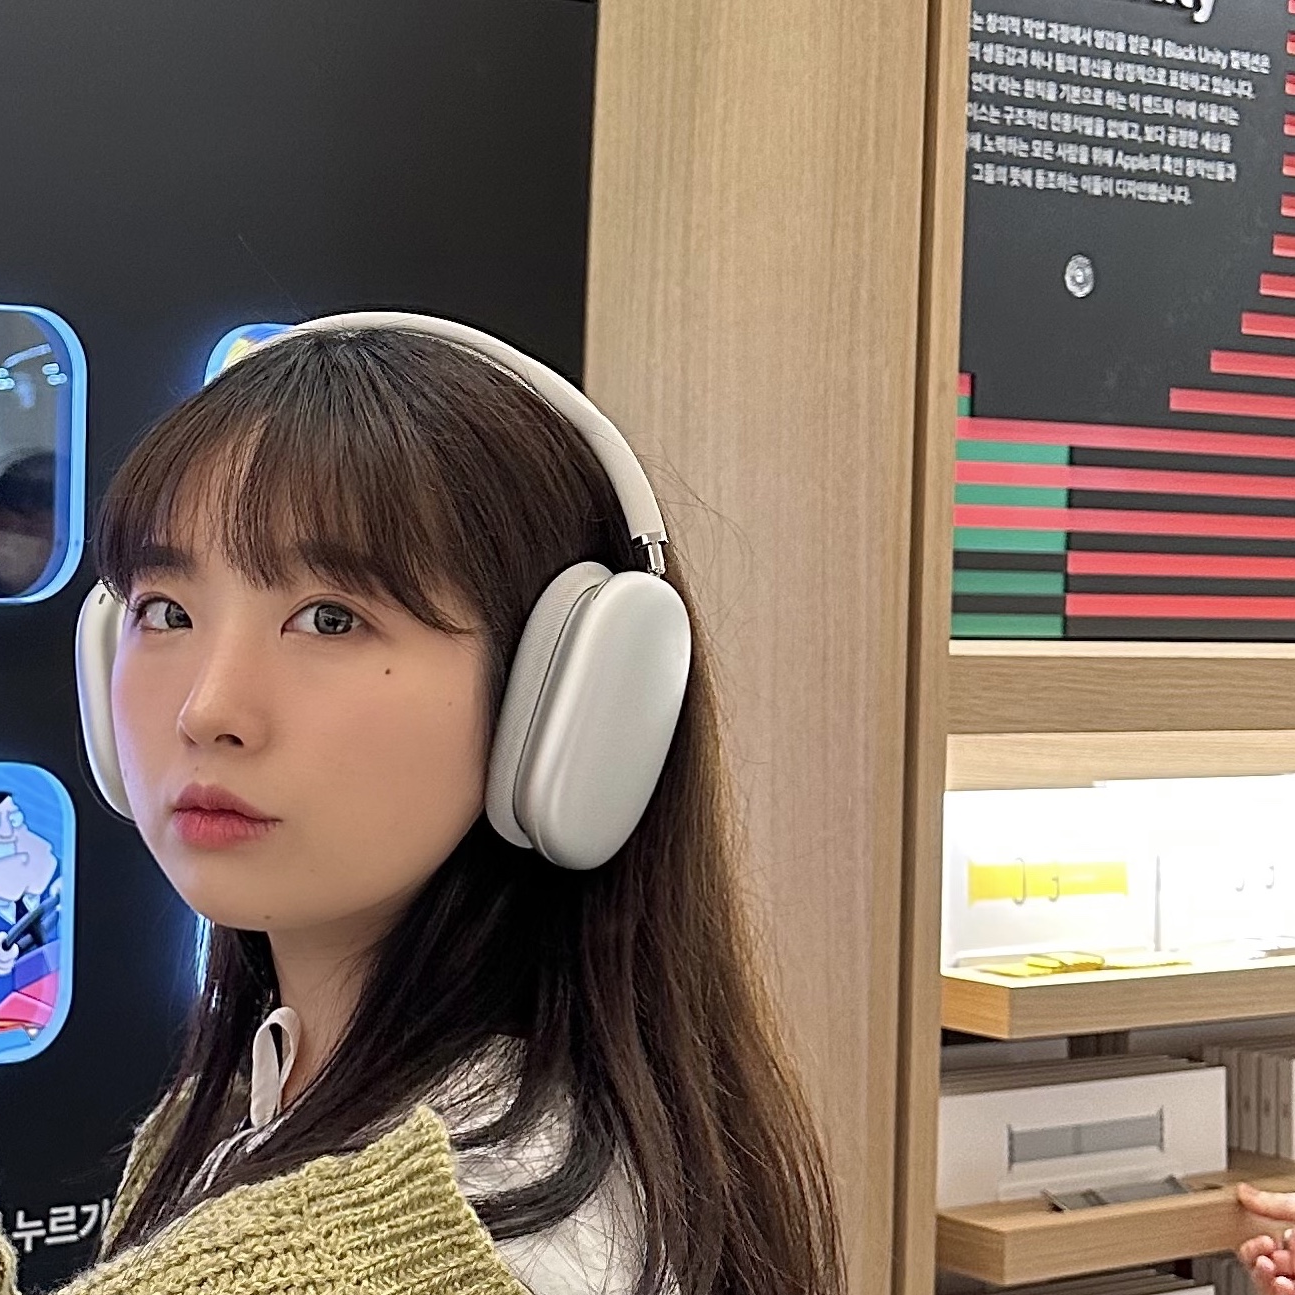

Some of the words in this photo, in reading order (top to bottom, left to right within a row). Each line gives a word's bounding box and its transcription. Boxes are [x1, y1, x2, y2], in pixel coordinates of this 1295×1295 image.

[1164, 39, 1197, 63] Black
[1197, 45, 1229, 70] Unity
[1059, 83, 1104, 107] 기본으로
[11, 1198, 111, 1251] 누르기
